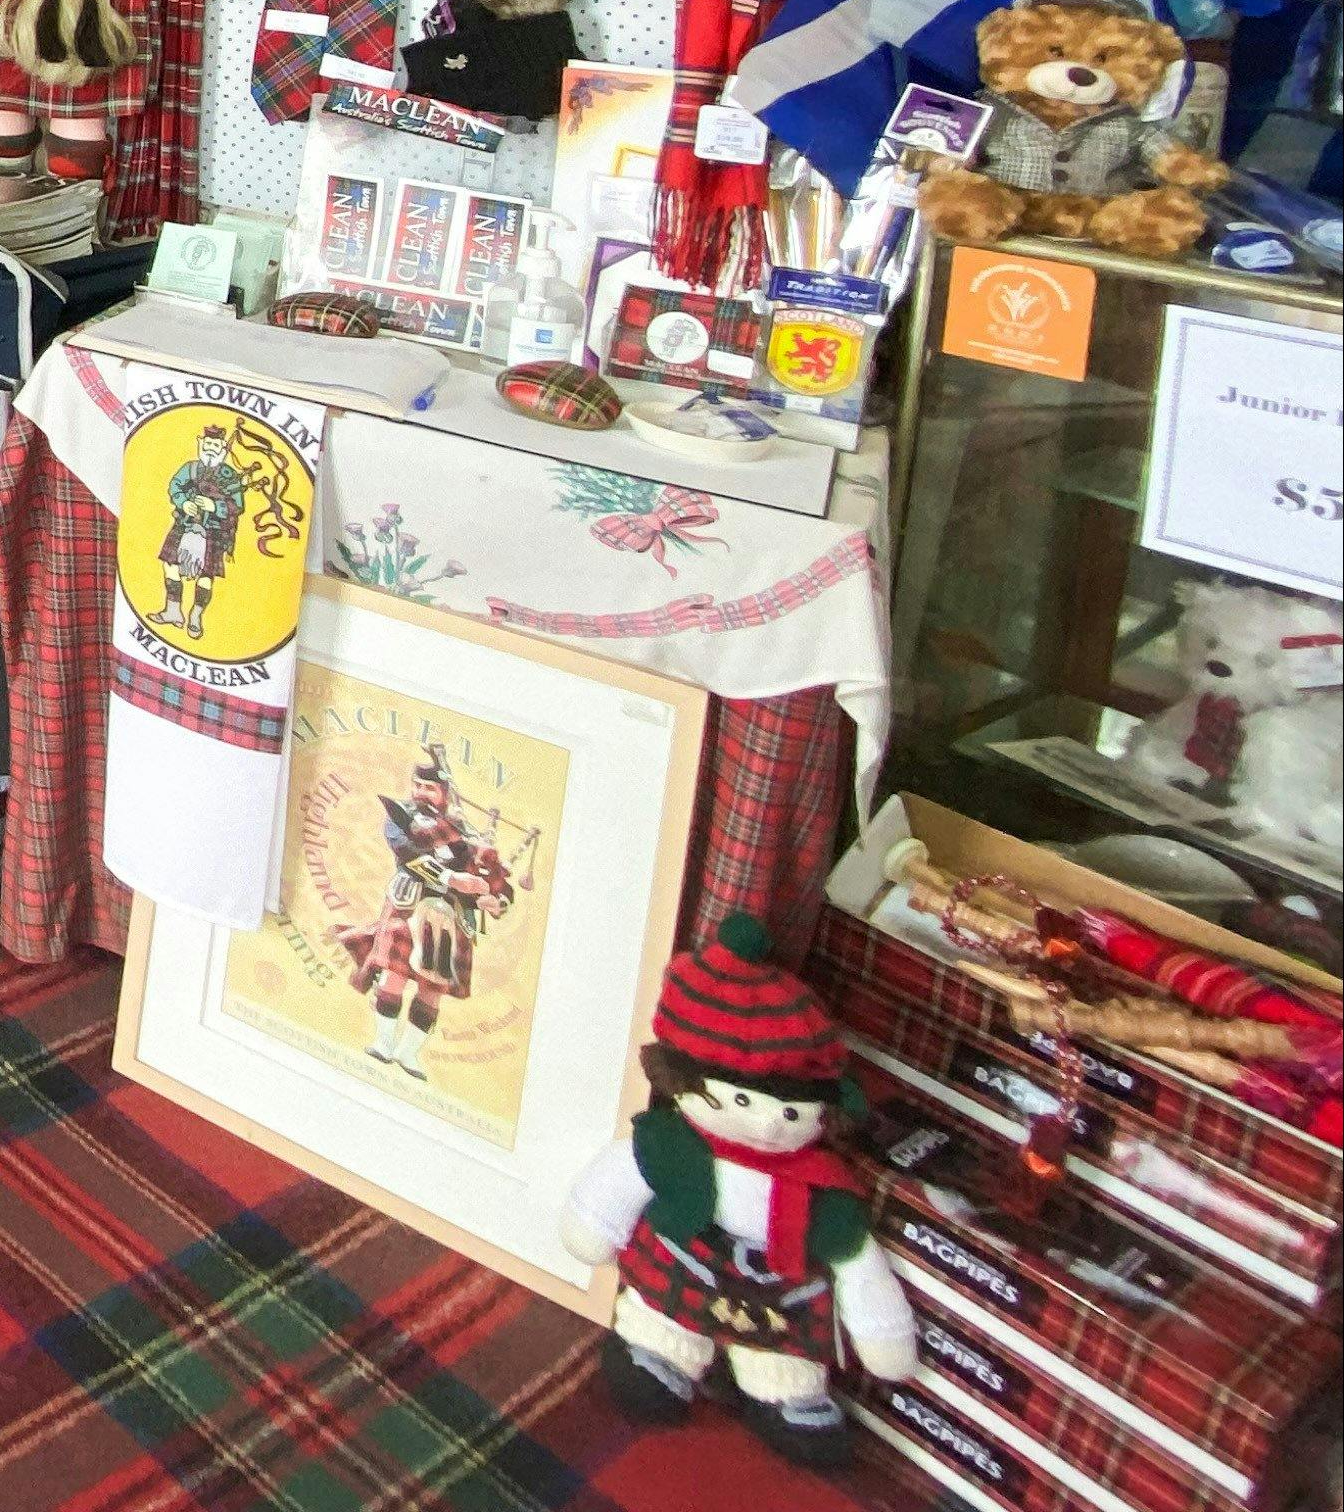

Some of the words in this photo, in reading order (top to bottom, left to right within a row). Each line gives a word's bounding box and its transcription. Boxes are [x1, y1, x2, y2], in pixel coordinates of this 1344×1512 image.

[349, 87, 483, 137] MACLEAN
[775, 310, 863, 334] SCOTLAND
[185, 381, 277, 419] TOWN
[277, 412, 322, 449] IN
[1216, 385, 1328, 422] Junior
[129, 623, 271, 687] MACLEAN
[292, 707, 517, 791] MACLEAN
[233, 1002, 262, 1023] THE
[265, 1019, 338, 1067] SCOTTISH
[412, 1088, 505, 1139] AUSTRALIA
[902, 1221, 1021, 1304] BAGPIPES
[891, 1392, 1006, 1484] BAGPIPES
